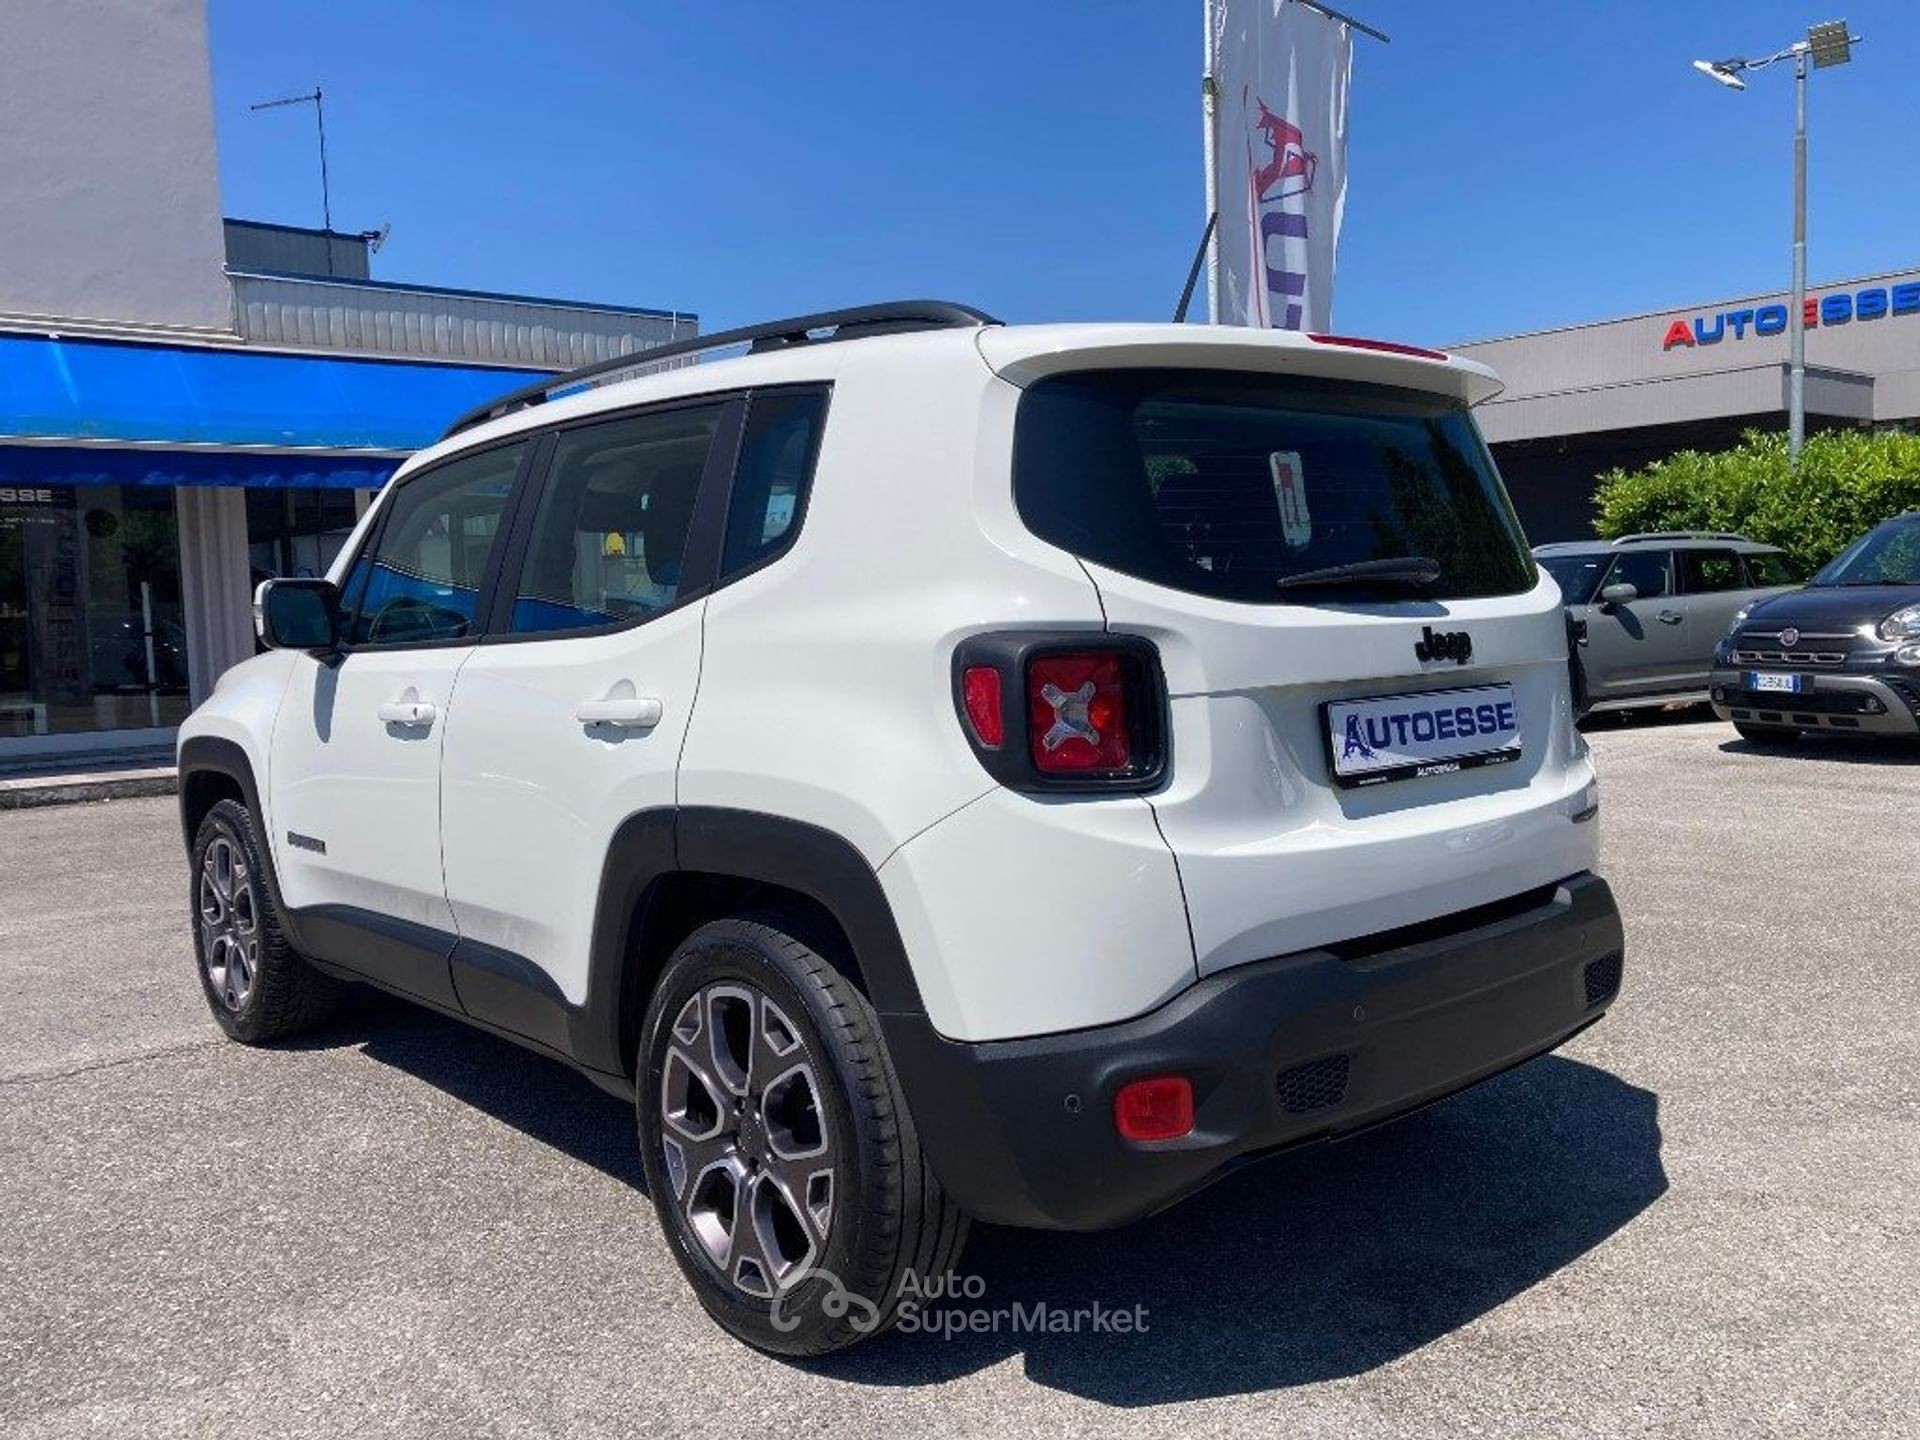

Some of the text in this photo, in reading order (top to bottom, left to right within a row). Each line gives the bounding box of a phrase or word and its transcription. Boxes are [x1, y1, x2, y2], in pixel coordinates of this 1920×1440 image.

[1663, 282, 1920, 351] AUTOESSE
[1415, 626, 1473, 665] Jeep
[1343, 701, 1516, 760] AUTOESSE
